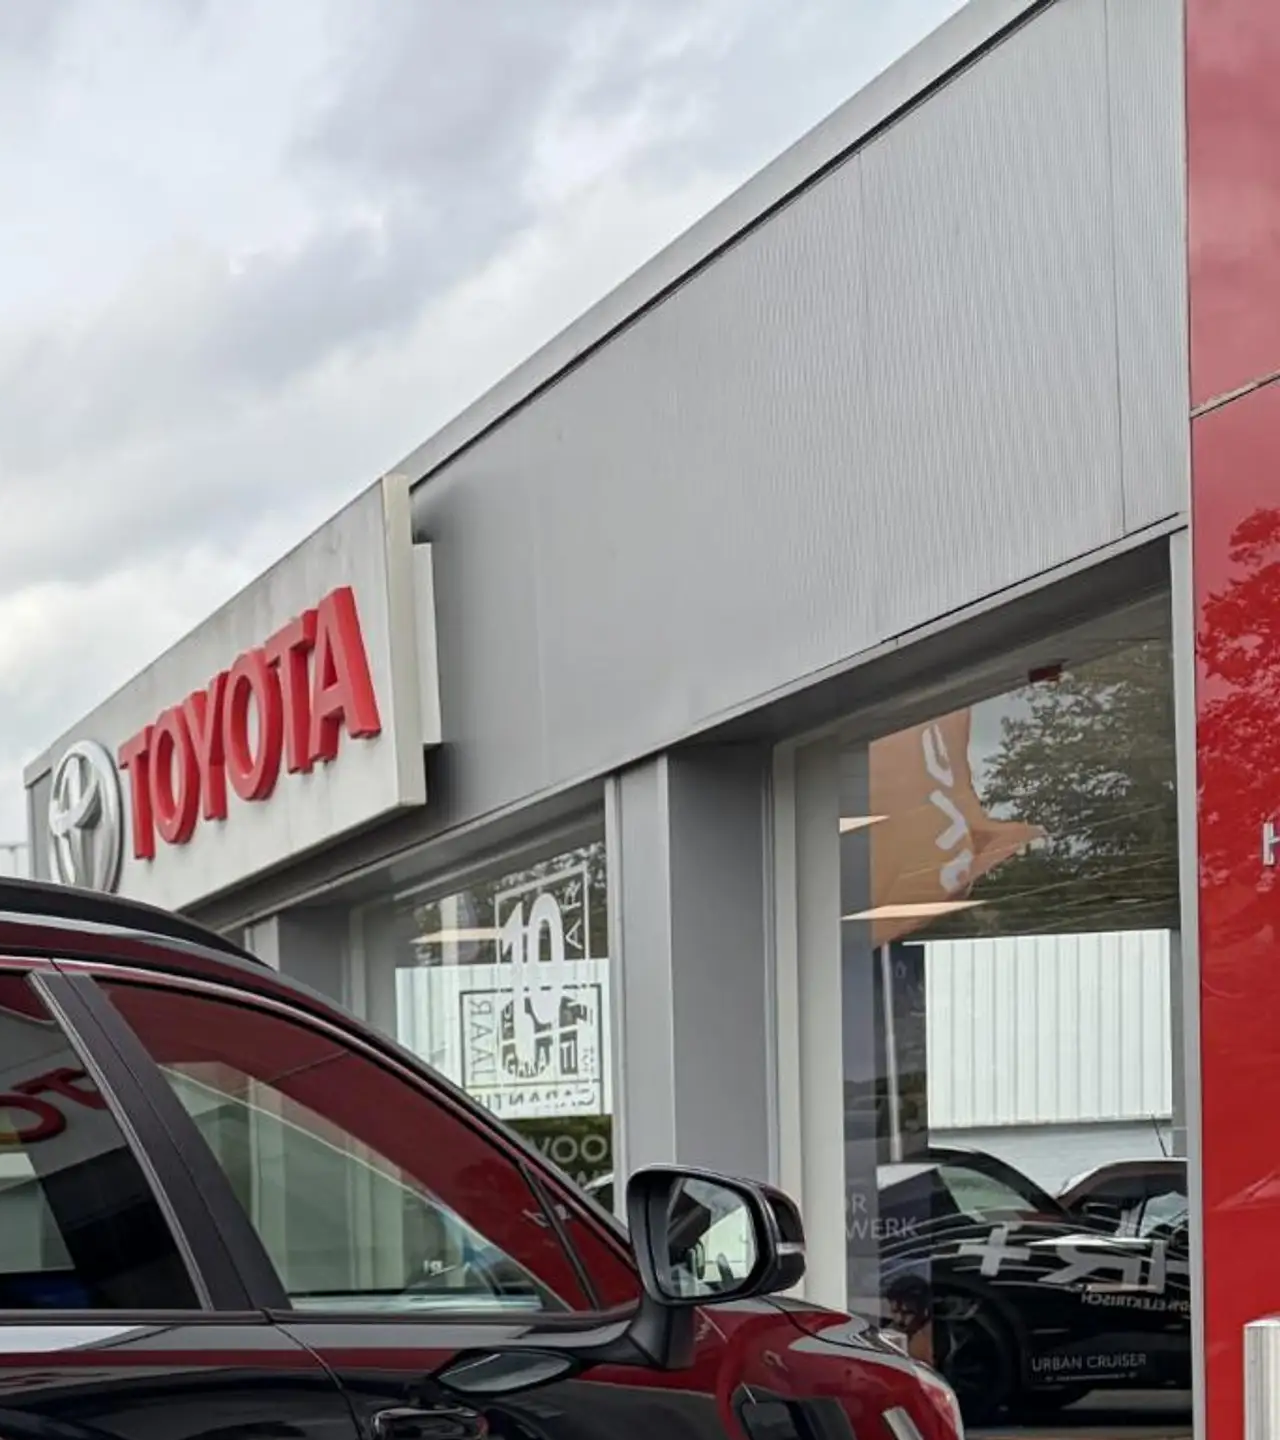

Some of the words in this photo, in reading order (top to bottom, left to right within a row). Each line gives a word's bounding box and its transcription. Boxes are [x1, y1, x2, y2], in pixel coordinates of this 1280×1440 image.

[117, 585, 382, 861] TOYOTA
[1031, 1355, 1083, 1373] URBAN
[1086, 1352, 1147, 1369] CRUISER
